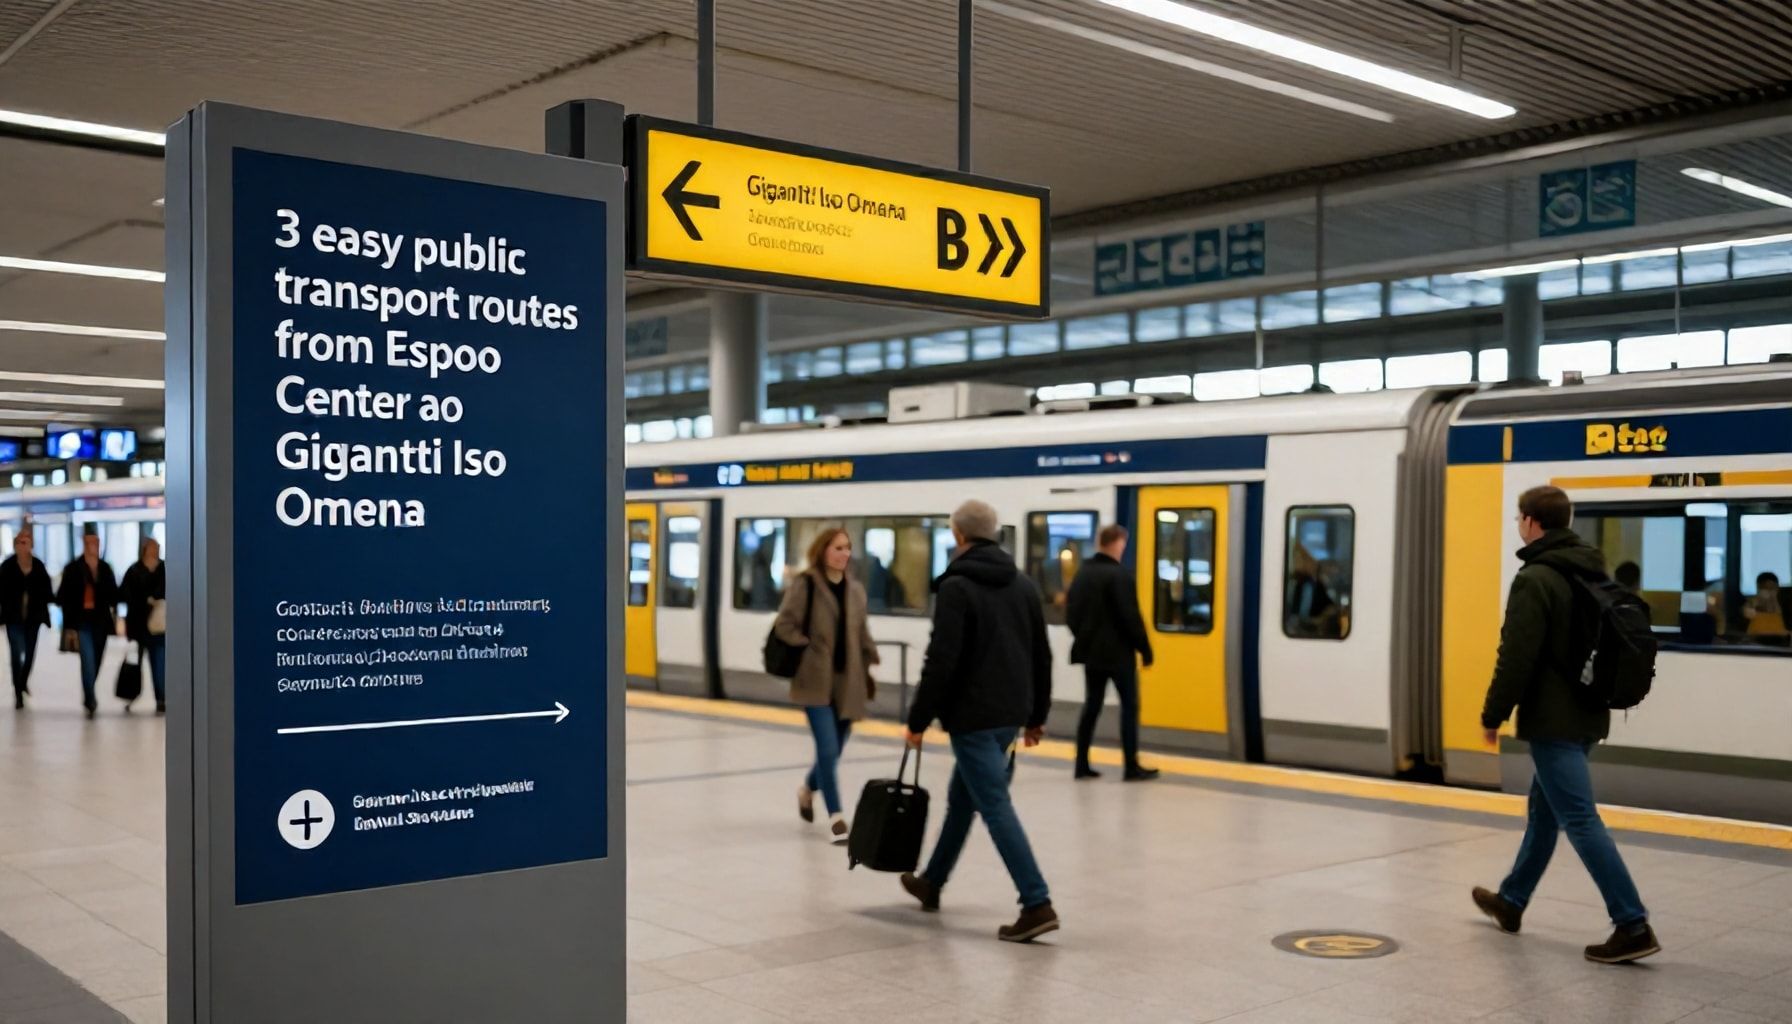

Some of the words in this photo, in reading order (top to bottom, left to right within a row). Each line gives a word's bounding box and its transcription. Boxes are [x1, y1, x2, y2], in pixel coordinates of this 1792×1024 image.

[274, 207, 301, 249] 3
[312, 222, 404, 270] easy
[414, 232, 527, 276] public
[936, 206, 970, 272] B
[274, 266, 461, 323] transport
[468, 294, 579, 331] routes
[274, 318, 374, 365] from
[385, 330, 502, 379] Espoo
[275, 374, 412, 420] Center
[418, 394, 464, 423] ao
[275, 431, 443, 482] Gigantti
[453, 439, 507, 478] Iso
[275, 486, 426, 528] Omena
